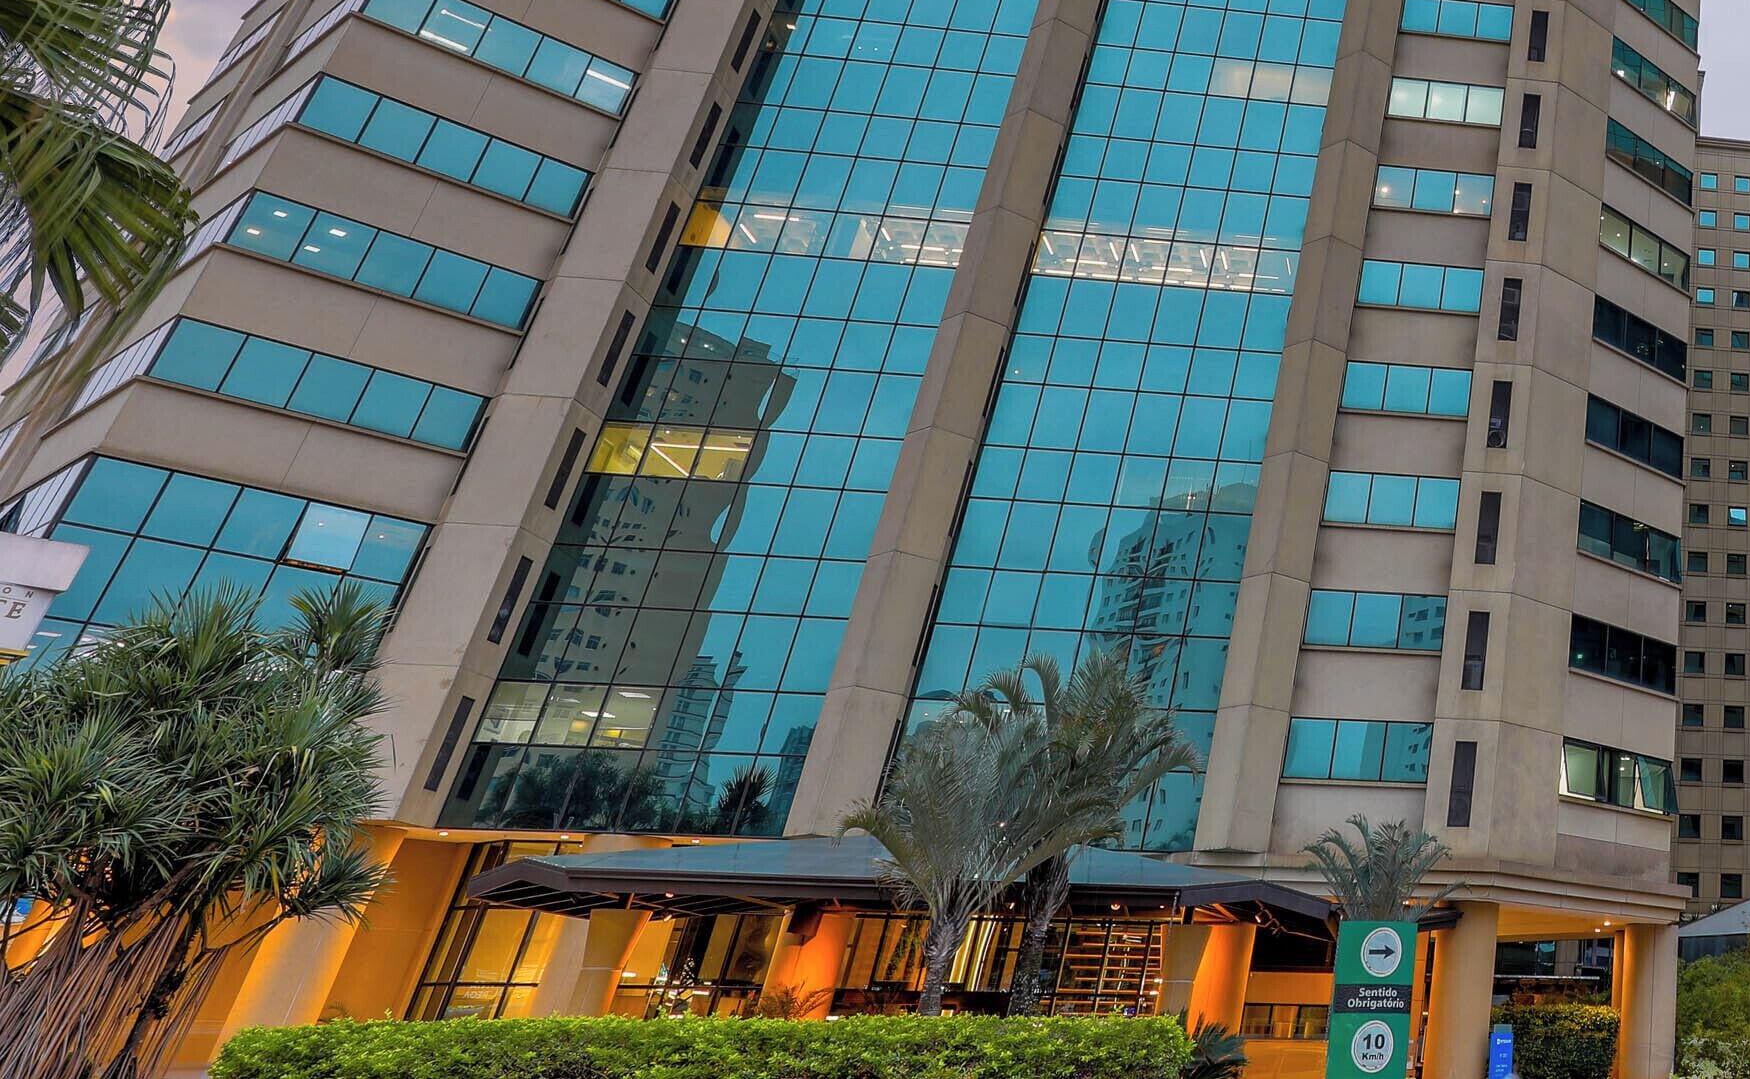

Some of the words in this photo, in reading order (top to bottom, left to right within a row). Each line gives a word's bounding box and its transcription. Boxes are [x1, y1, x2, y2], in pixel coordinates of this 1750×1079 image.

[1358, 987, 1398, 997] Sentido
[1347, 998, 1404, 1009] Obrigatório
[1363, 1034, 1385, 1049] 10
[1361, 1052, 1384, 1061] Km/h
